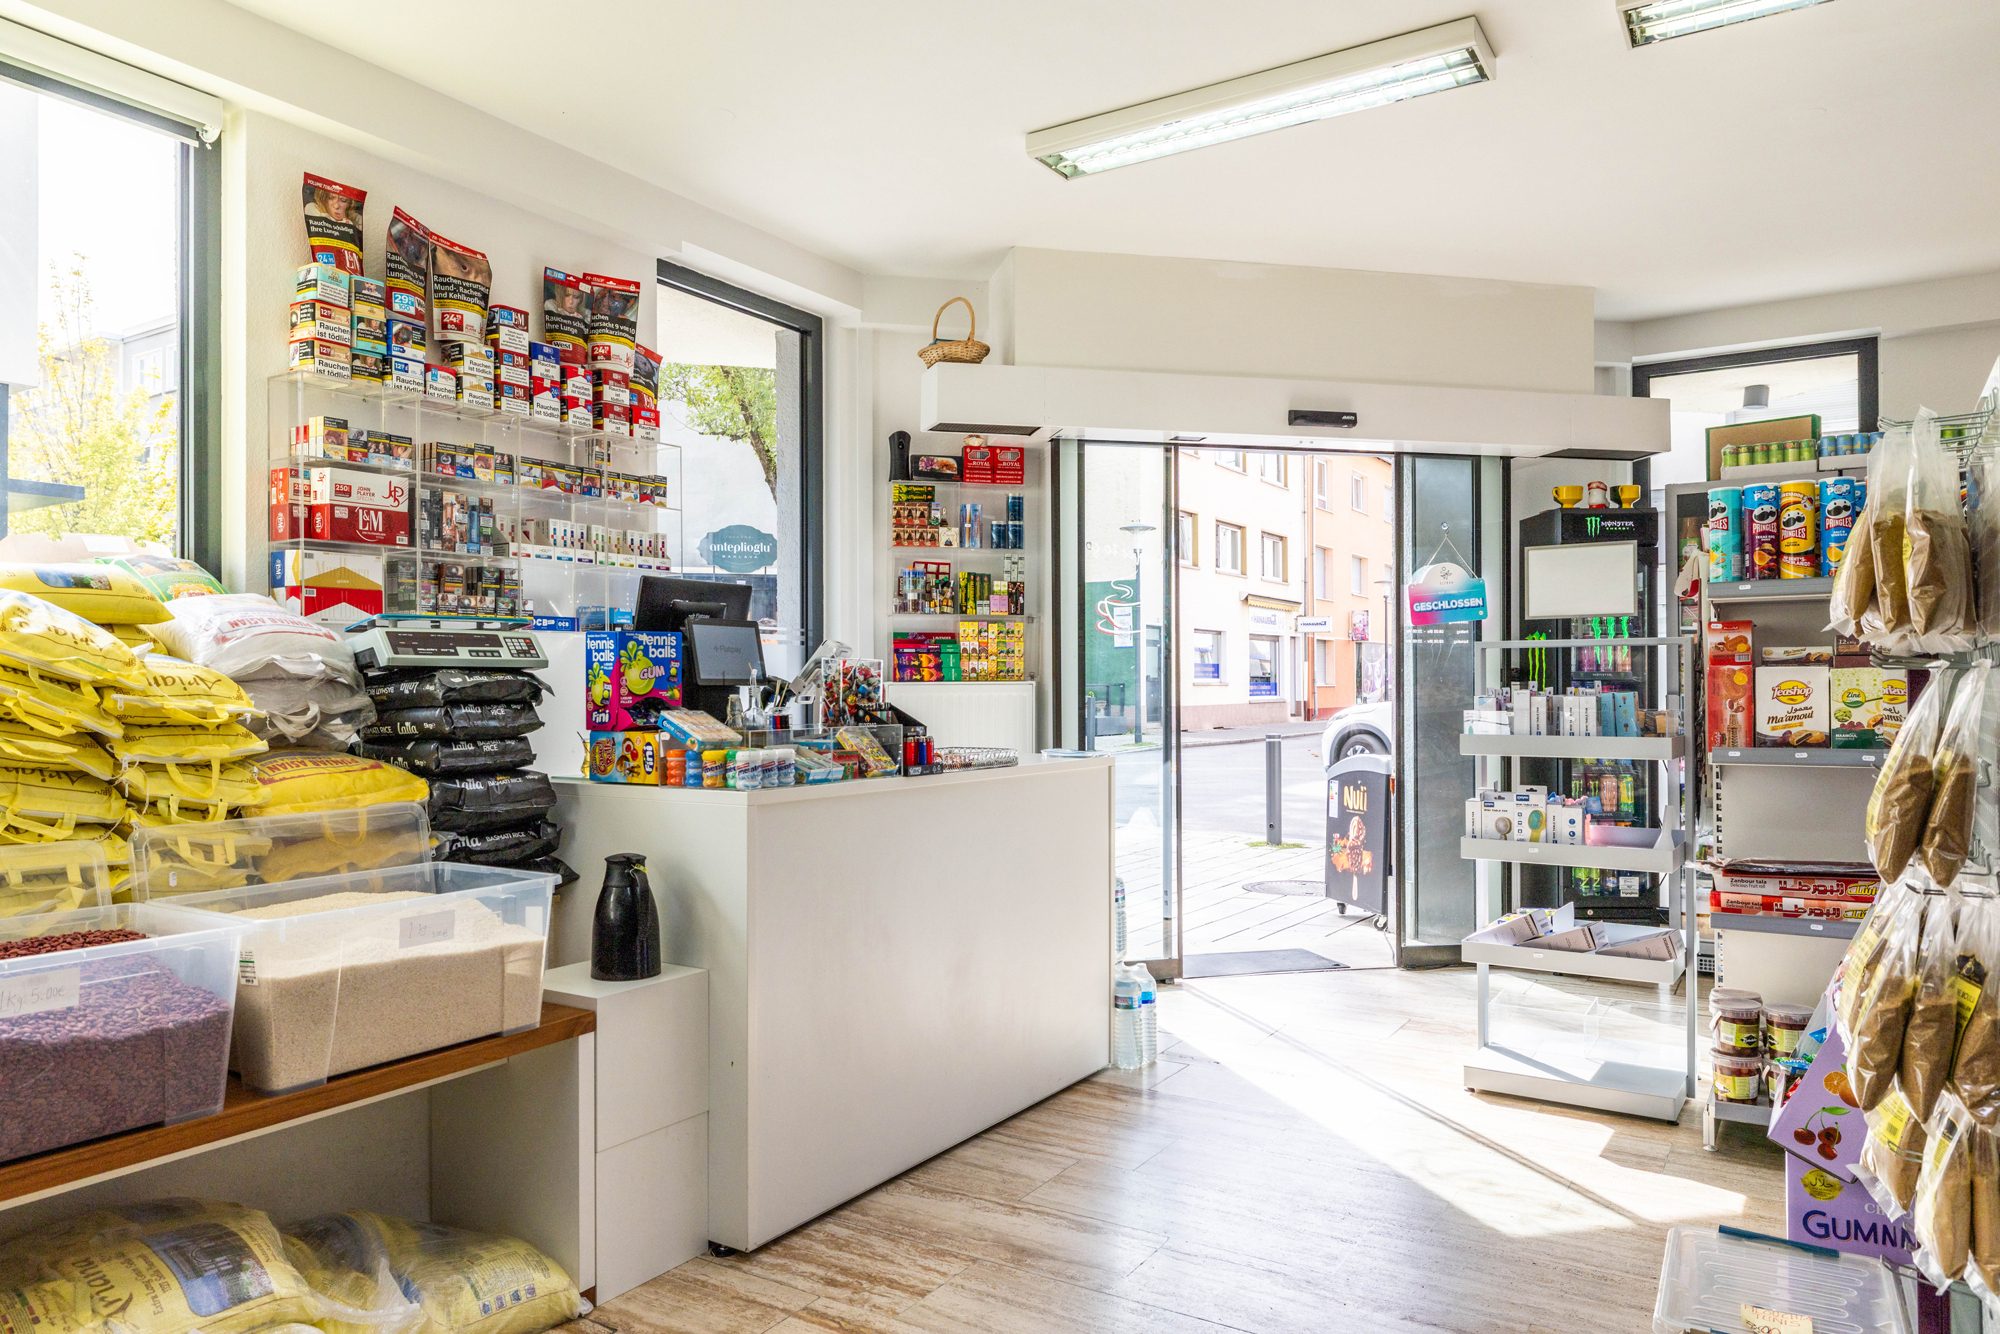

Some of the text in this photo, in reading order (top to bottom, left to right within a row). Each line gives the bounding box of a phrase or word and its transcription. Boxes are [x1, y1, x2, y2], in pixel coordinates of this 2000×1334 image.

[309, 220, 332, 228] Rauchen
[324, 228, 340, 236] Lunge
[434, 275, 462, 286] Rauchen
[546, 315, 571, 324] Rauchen
[320, 322, 350, 334] Rauchen
[560, 324, 578, 334] Lunge
[328, 332, 350, 343] tödlich
[318, 360, 350, 372] Rauchen
[470, 360, 492, 370] Rauchen
[538, 360, 556, 368] Rauchen
[316, 368, 350, 379] ist tödlich
[476, 367, 492, 376] tödlich
[396, 376, 424, 386] Rauchen
[429, 384, 456, 394] Rauchen
[572, 383, 590, 392] Rauchen
[608, 386, 626, 394] Rauchen
[468, 392, 490, 402] Rauchen
[475, 399, 492, 408] tödlich
[536, 402, 560, 412] Rauchen
[543, 410, 560, 419] tödlich
[572, 413, 590, 421] Rauchen
[609, 420, 626, 428] Rauchen
[359, 510, 383, 532] L&M
[1825, 516, 1852, 530] PRINGLES
[1752, 522, 1778, 534] PRINGLES
[1781, 527, 1806, 540] PRINGLES
[1412, 597, 1484, 612] GESCHLOSSEN
[587, 637, 614, 650] tennis
[643, 633, 676, 646] tennis
[592, 650, 614, 662] balls
[649, 646, 676, 658] balls
[640, 666, 665, 679] GUM
[1772, 685, 1813, 700] Teashop
[1767, 711, 1814, 724] Ma'amoul
[267, 760, 306, 773] ASIAN
[486, 833, 512, 842] BASMATI
